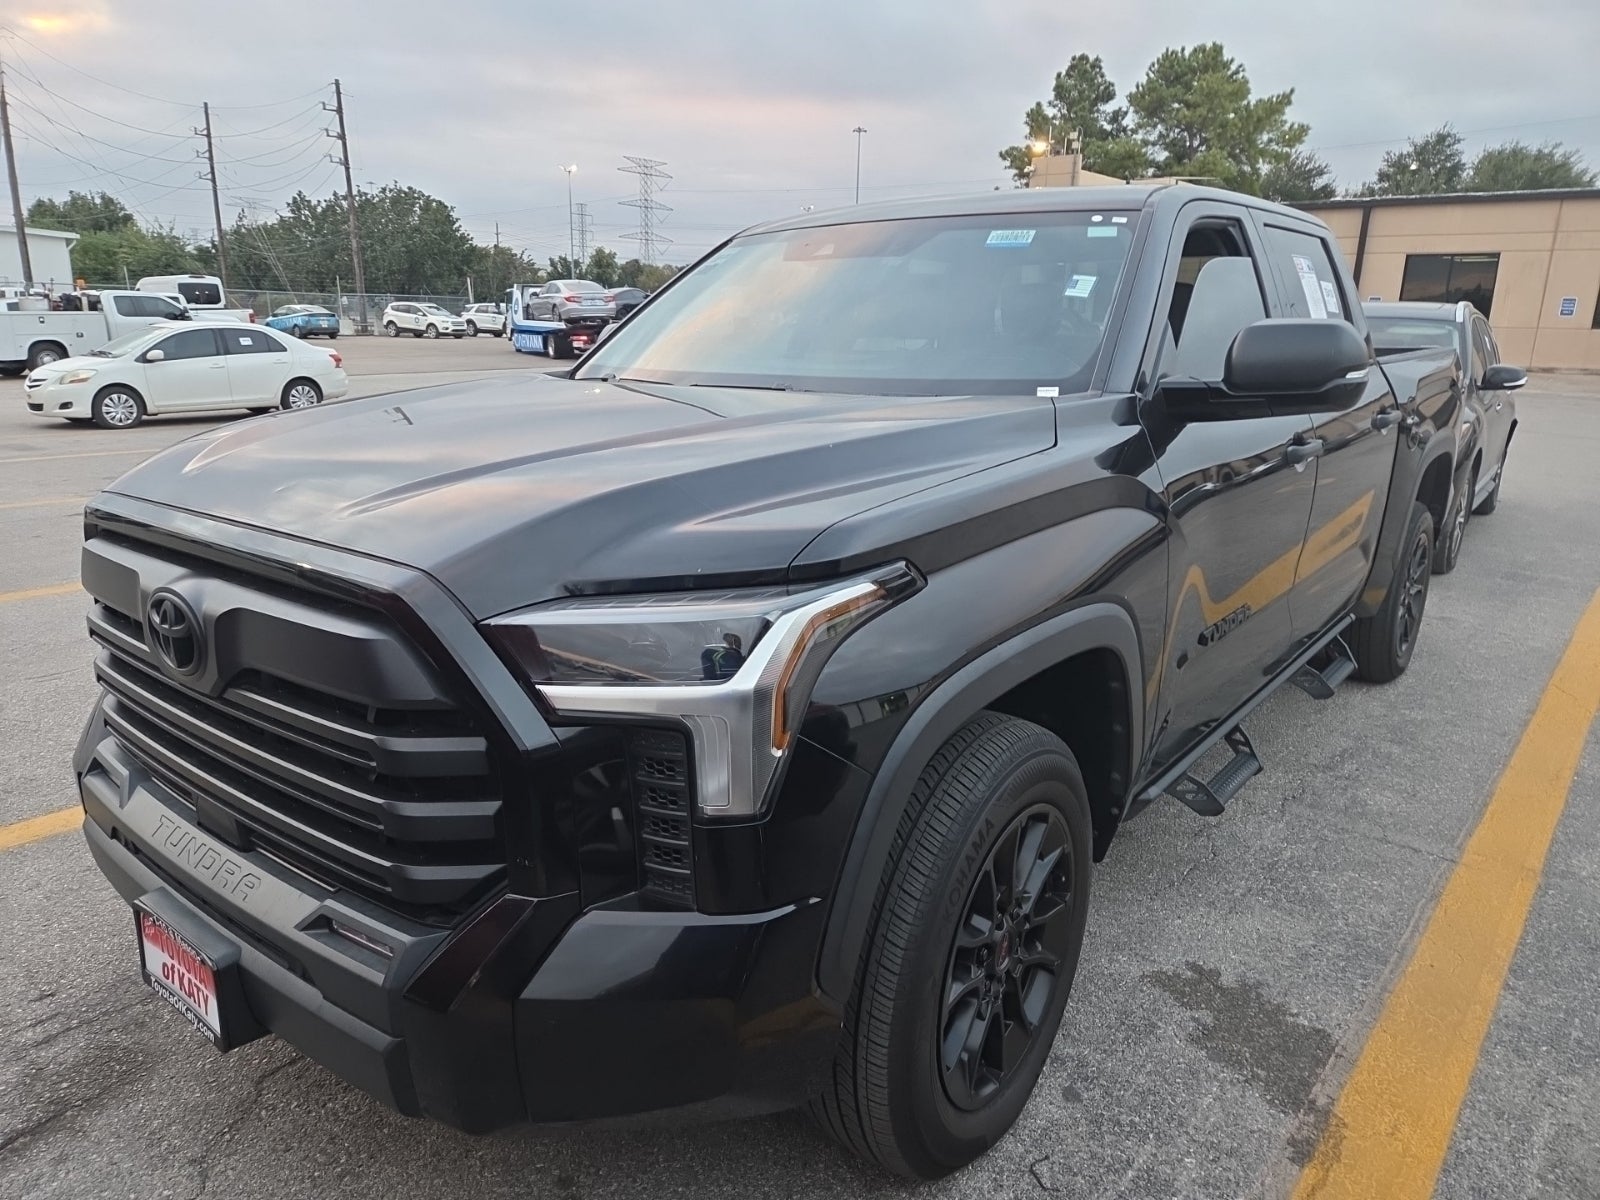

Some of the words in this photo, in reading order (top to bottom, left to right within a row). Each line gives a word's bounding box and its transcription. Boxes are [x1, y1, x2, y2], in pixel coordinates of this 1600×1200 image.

[152, 814, 262, 904] TUNDRA
[156, 926, 208, 991] TOYOTA
[162, 962, 175, 985] of
[177, 967, 209, 1017] KATY
[150, 975, 215, 1042] ToyotaOfKaty.com
